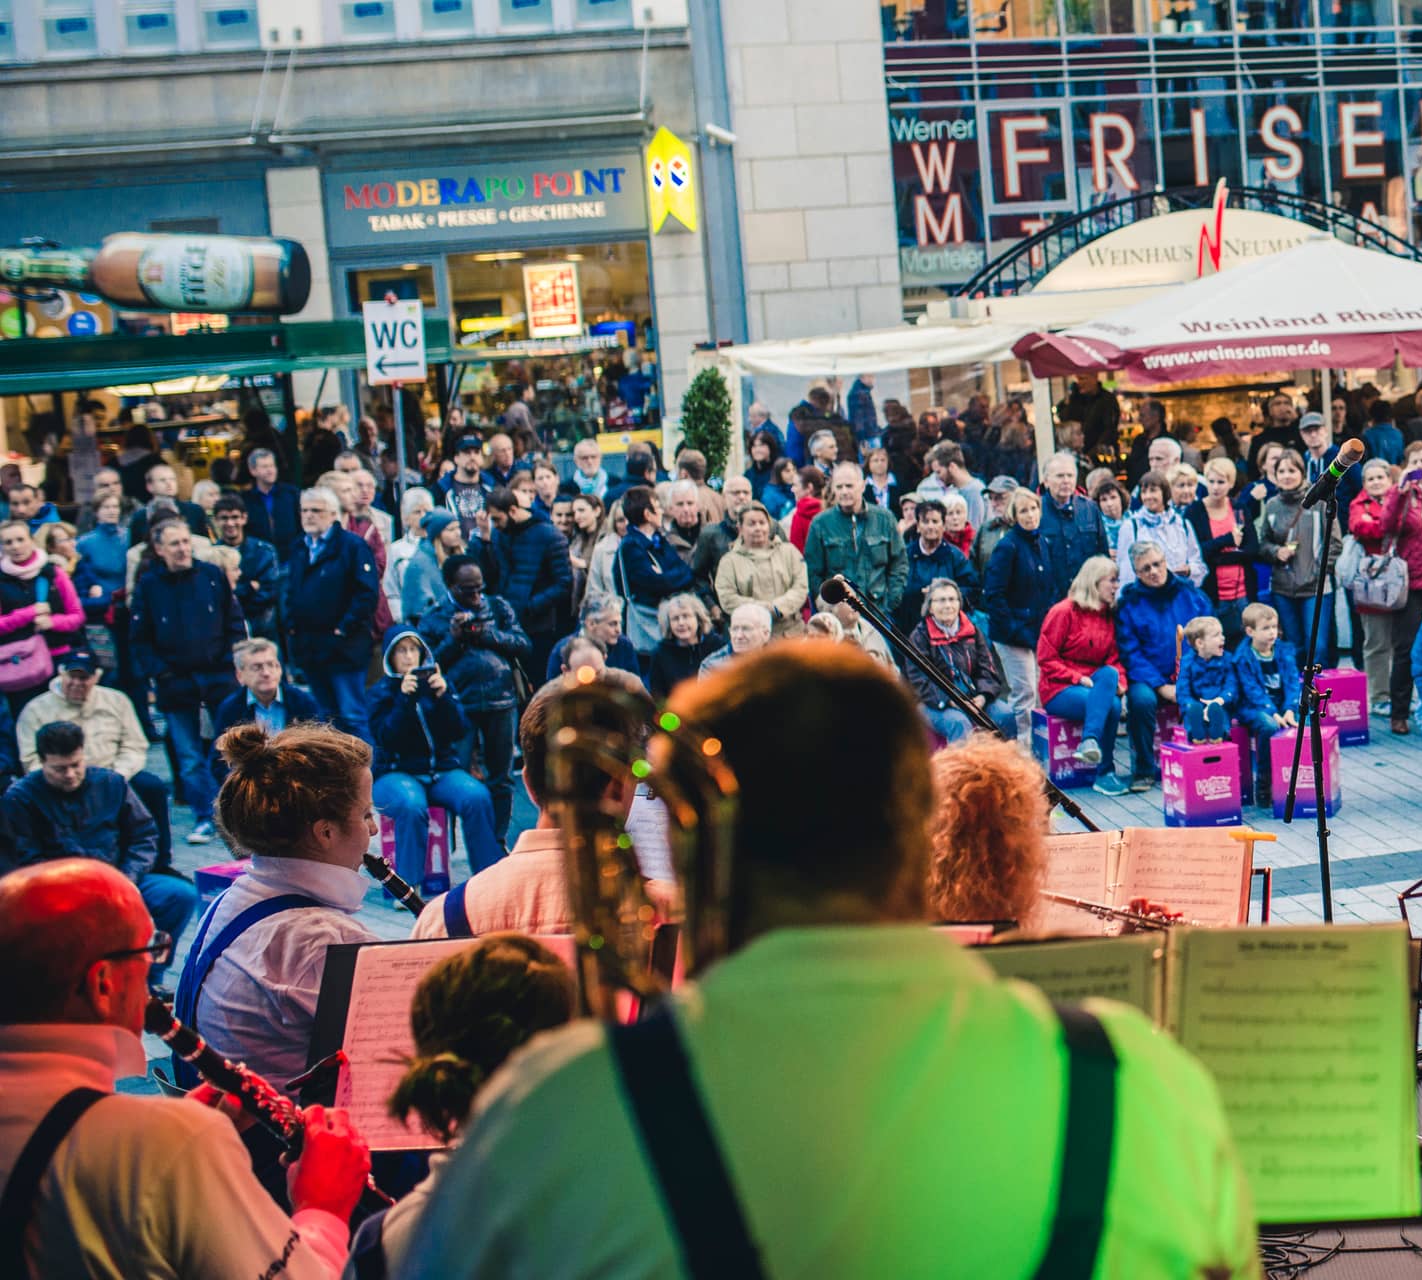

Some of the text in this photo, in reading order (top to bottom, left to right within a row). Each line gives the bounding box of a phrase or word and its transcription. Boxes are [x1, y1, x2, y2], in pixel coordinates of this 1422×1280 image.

[891, 117, 976, 141] Werner
[912, 141, 956, 194] W
[344, 168, 626, 210] MODERAPO POINT
[368, 201, 606, 232] TABAK PRESSE GESCHENKE
[914, 193, 964, 247] M
[1087, 244, 1193, 267] WEINHAUS
[371, 319, 418, 348] WC
[1181, 311, 1329, 334] Weinland
[1143, 338, 1331, 370] www.weinsommer.de
